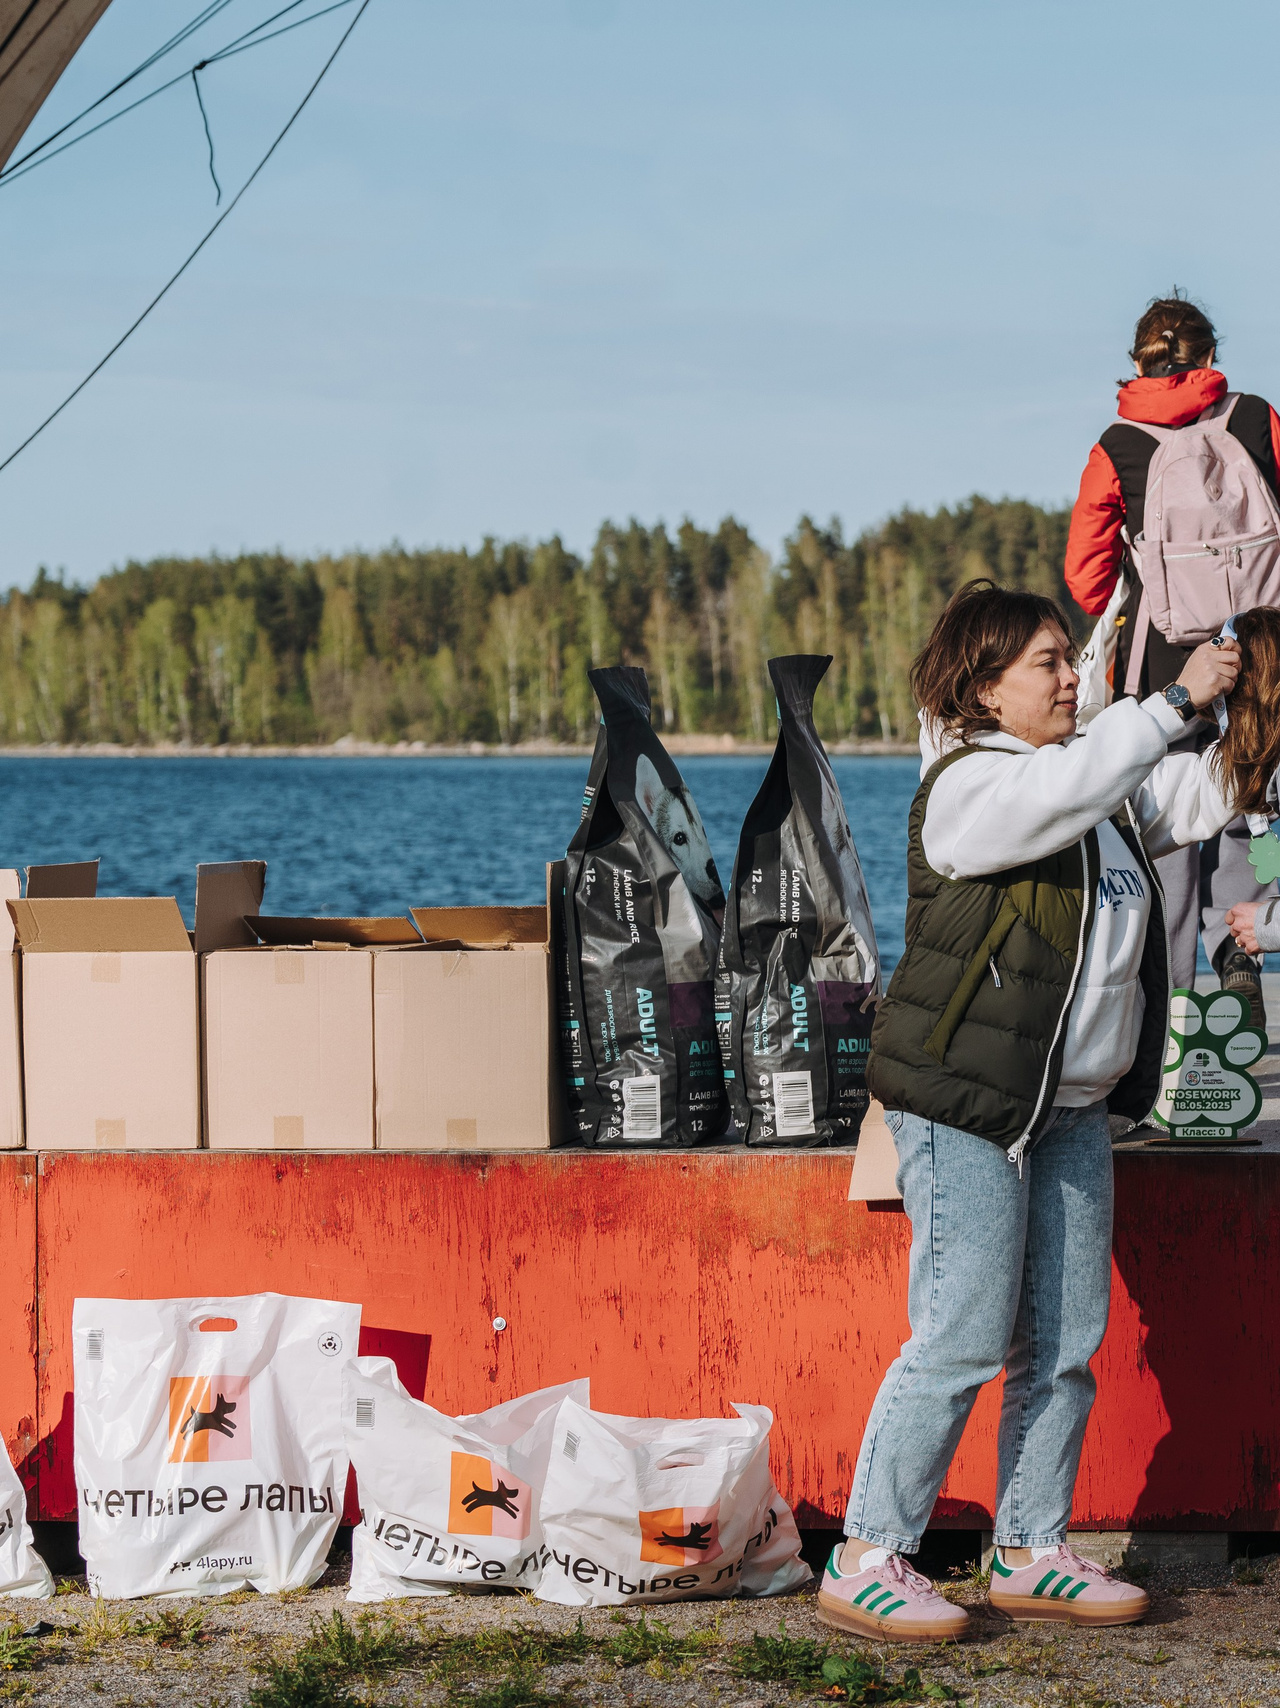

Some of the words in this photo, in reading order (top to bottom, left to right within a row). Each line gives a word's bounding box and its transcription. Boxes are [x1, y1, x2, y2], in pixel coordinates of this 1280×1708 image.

[585, 867, 596, 883] 12
[623, 868, 633, 898] LAMB
[752, 868, 763, 883] 12
[779, 869, 788, 901] ЯГНЁНОК
[791, 869, 800, 898] LAMB
[625, 899, 636, 922] AND
[780, 901, 787, 909] И
[791, 899, 800, 923] AND
[629, 922, 640, 944] RICE
[604, 989, 613, 1004] ДЛЯ
[607, 1004, 617, 1040] ВЗРОСЛЫХ
[635, 987, 660, 1057] ADULT
[789, 983, 810, 1052] ADULT
[600, 1022, 609, 1039] ВСЕХ
[602, 1039, 612, 1063] ПОРОД
[611, 1040, 621, 1062] СОБАК
[688, 1039, 717, 1056] ADU
[753, 1032, 761, 1056] ПОРОД
[837, 1038, 871, 1053] ADUL
[689, 1091, 711, 1101] LAMB
[839, 1088, 857, 1098] LAMB
[1166, 1090, 1240, 1100] NOSEWORK
[1175, 1101, 1230, 1110] 18.05.2025
[690, 1119, 703, 1132] 12
[1182, 1128, 1216, 1136] Класс:
[1218, 1128, 1226, 1136] 0
[83, 1486, 228, 1518] четыре
[240, 1483, 334, 1514] лапы
[196, 1555, 253, 1573] 4lapy.ru
[552, 1549, 700, 1596] четыре
